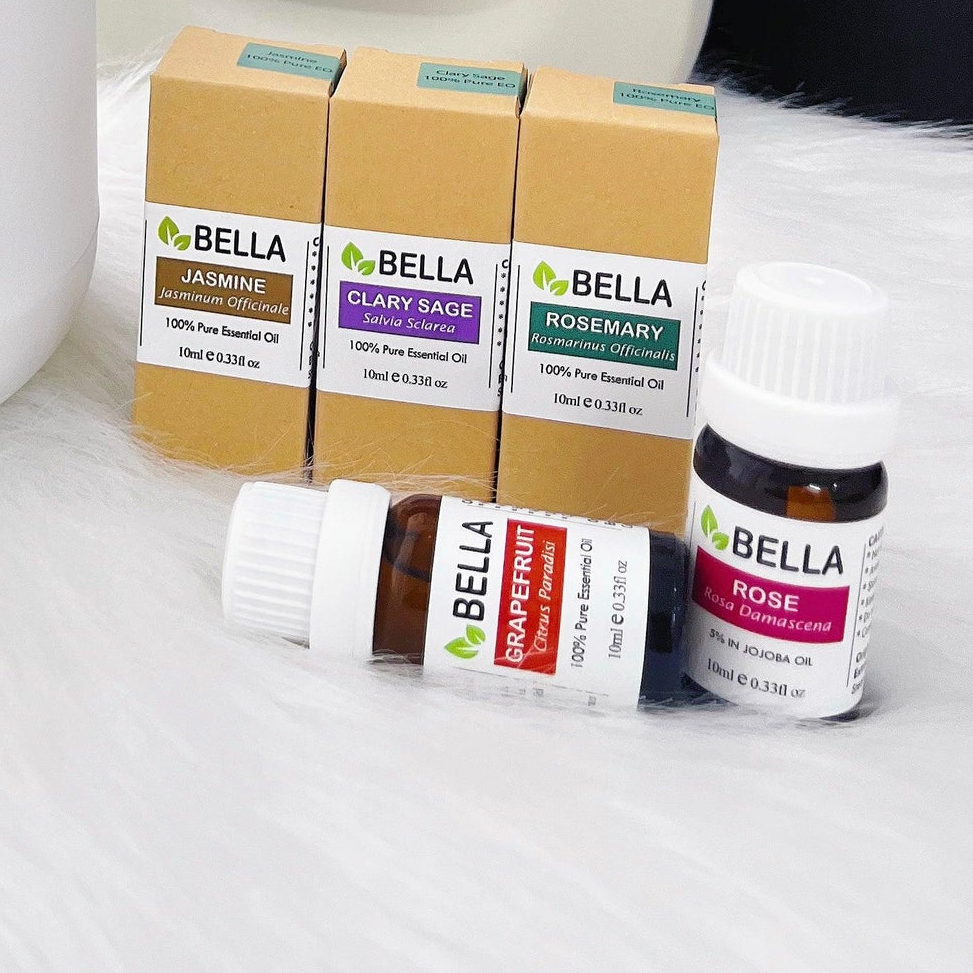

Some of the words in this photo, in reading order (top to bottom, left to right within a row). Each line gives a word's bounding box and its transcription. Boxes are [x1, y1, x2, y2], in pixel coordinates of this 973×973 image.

[283, 60, 312, 69] Pure
[436, 69, 469, 78] Clary
[473, 73, 505, 81] Sage
[425, 75, 460, 83] 100%
[464, 79, 494, 87] Pure
[194, 224, 286, 262] BELLA
[181, 268, 267, 295] JASMINE
[379, 249, 474, 285] BELLA
[158, 287, 223, 306] Jasminum
[227, 295, 289, 316] Officinale
[572, 269, 673, 308] BELLA
[347, 289, 412, 311] CLARY
[417, 298, 474, 319] SAGE
[165, 317, 195, 331] 100%
[197, 322, 219, 335] Pure
[221, 326, 262, 342] Essential
[264, 332, 279, 344] Oil
[362, 312, 403, 328] Salvia
[406, 317, 456, 334] Sclarea
[545, 311, 664, 341] ROSEMARY
[179, 346, 203, 360] 10ml
[216, 352, 245, 367] 0.33fl
[247, 360, 261, 369] oz
[349, 339, 380, 354] 100%
[382, 344, 405, 357] Pure
[407, 347, 449, 363] Essential
[451, 352, 467, 364] Oil
[531, 332, 606, 352] Rosmarinus
[610, 343, 675, 362] Officinalis
[363, 368, 389, 382] 10ml
[402, 374, 432, 388] 0.33fl
[434, 379, 448, 389] oz
[539, 363, 571, 378] 100%
[574, 368, 598, 381] Pure
[600, 371, 645, 388] Essential
[647, 378, 664, 391] Oil
[553, 392, 580, 407] 10ml
[594, 398, 626, 414] 0.33fl
[628, 406, 643, 416] oz
[580, 538, 593, 552] Oil
[732, 526, 844, 576] BELLA
[452, 521, 494, 622] BELLA
[538, 539, 556, 601] Paradisi
[577, 554, 592, 601] Essential
[619, 560, 628, 574] oz
[505, 524, 535, 663] GRAPEFRUIT
[612, 576, 628, 612] 0.33fl
[703, 585, 735, 612] Rosa
[739, 601, 833, 632] Damascena
[732, 579, 800, 613] ROSE
[533, 606, 551, 653] Citrus
[574, 603, 590, 632] Pure
[571, 633, 587, 668] 100%
[608, 627, 624, 660] 10ml
[709, 628, 725, 644] 5%
[728, 637, 740, 651] IN
[743, 642, 791, 664] JOJOBA
[794, 655, 814, 667] OIL
[707, 658, 735, 682] 10ml
[750, 675, 787, 697] 0.33fl
[790, 688, 806, 698] oz
